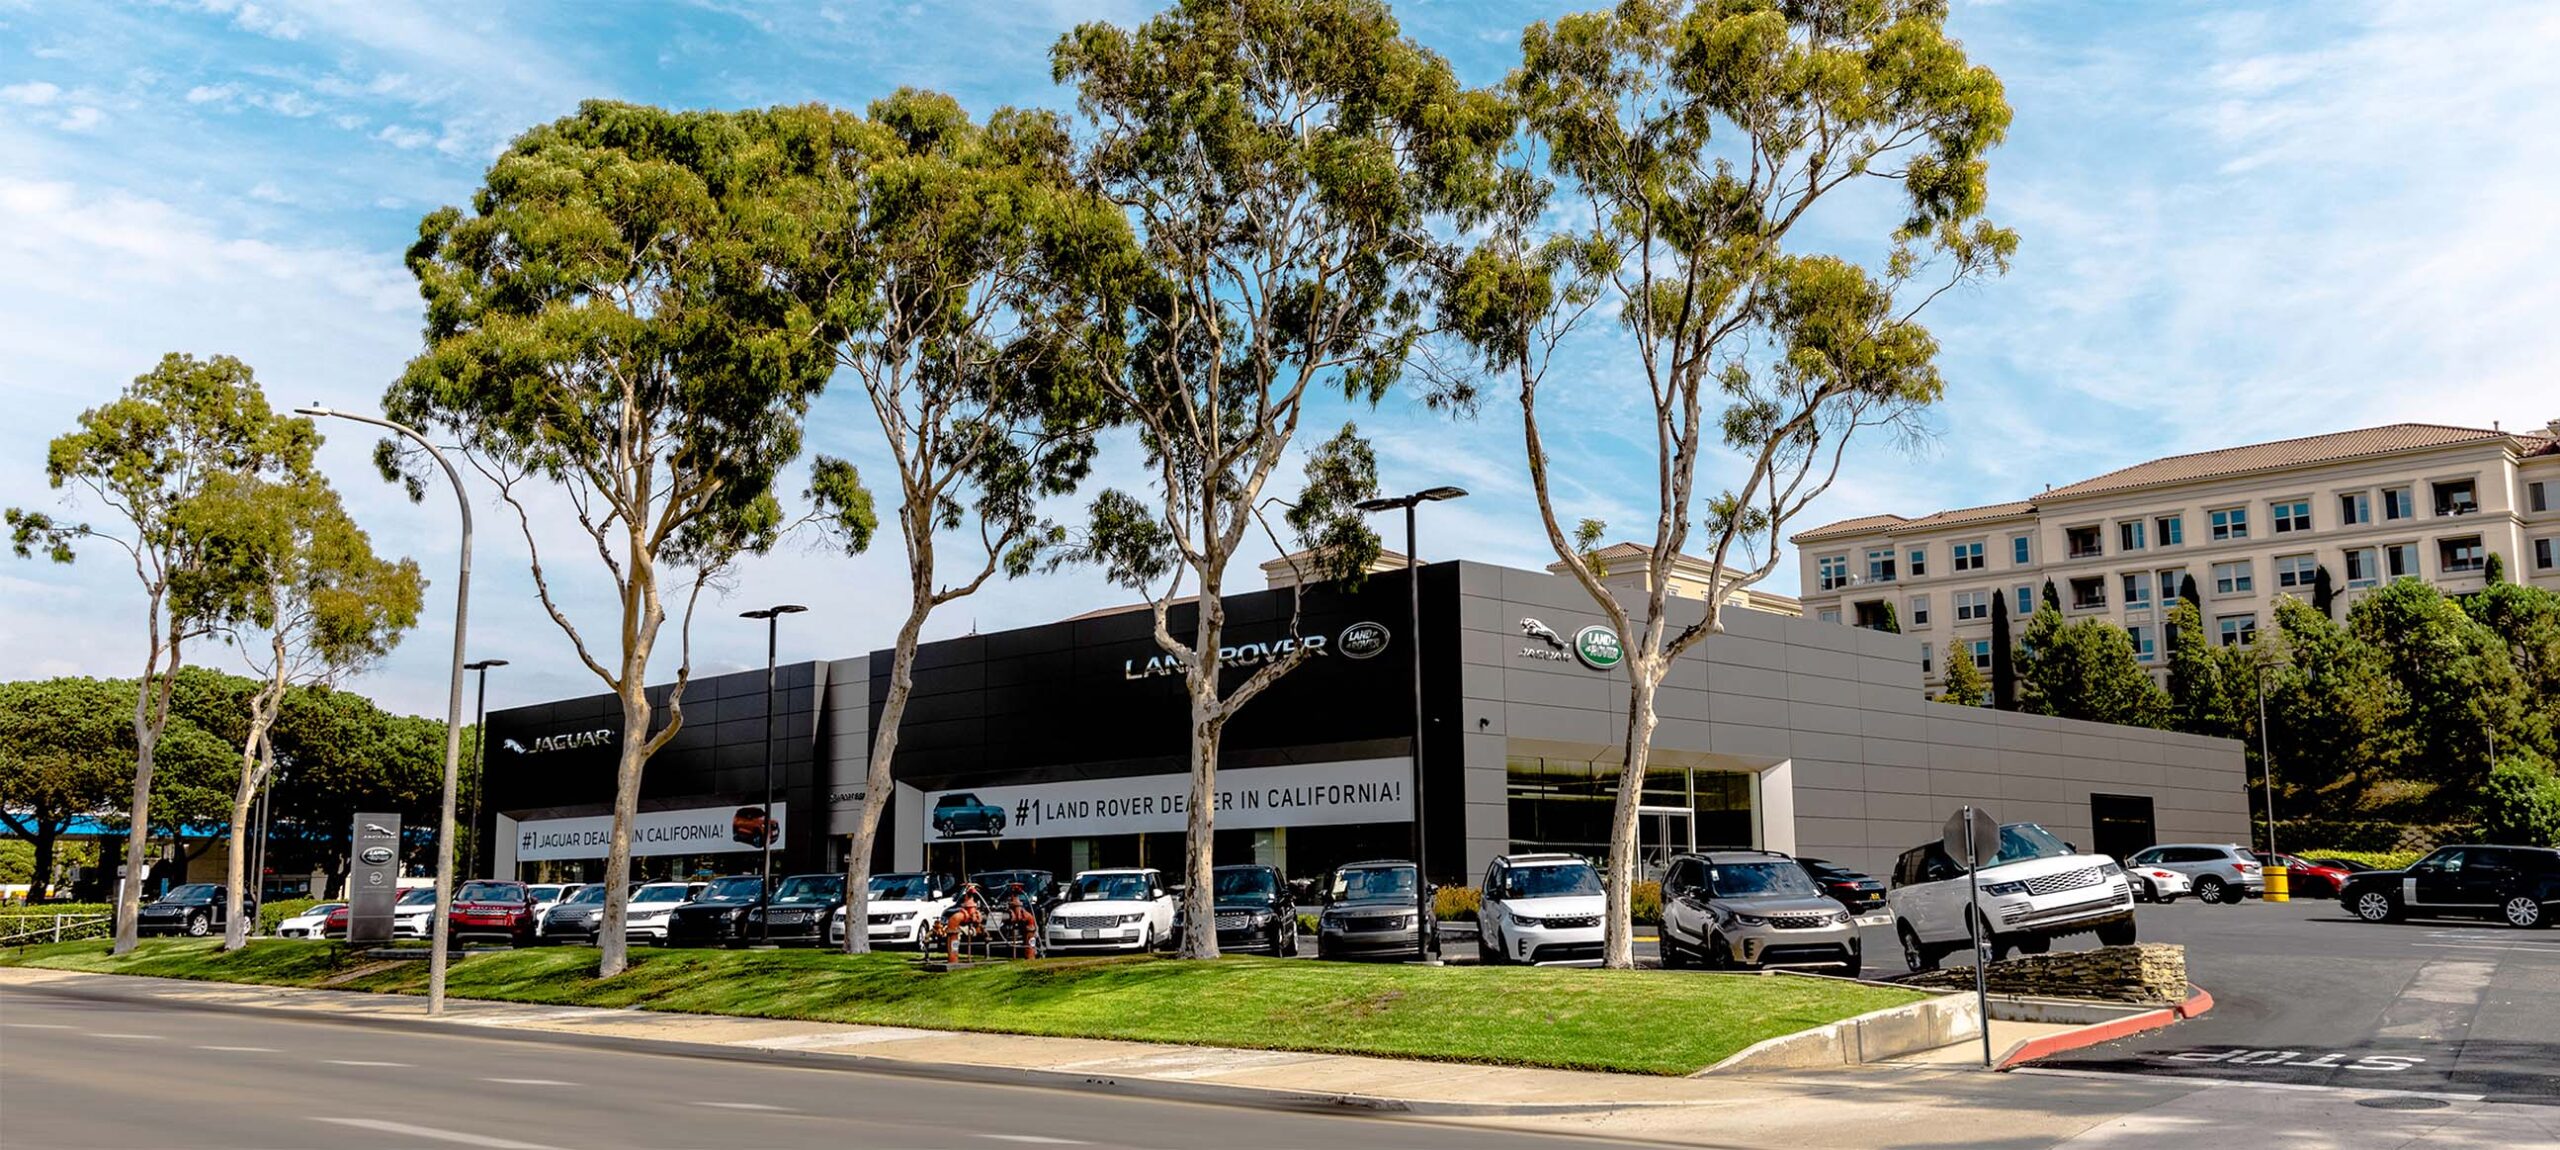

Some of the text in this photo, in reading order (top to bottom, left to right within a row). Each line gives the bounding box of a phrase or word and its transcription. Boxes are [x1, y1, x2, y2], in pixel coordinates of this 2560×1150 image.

[1349, 630, 1373, 642] LAND
[1588, 632, 1611, 645] LAND
[1126, 635, 1328, 680] LAN ROVER
[1519, 647, 1572, 662] JAGUAR
[1590, 645, 1618, 659] ROVER
[528, 729, 611, 754] JAGUAR
[1015, 781, 1400, 826] #1 LAND ROVER DEER IN CALIFORNIA!
[522, 831, 537, 850] #1
[539, 832, 580, 849] JAGUAR
[646, 824, 724, 842] CALIFORNIA!
[2168, 1050, 2425, 1071] STOP
